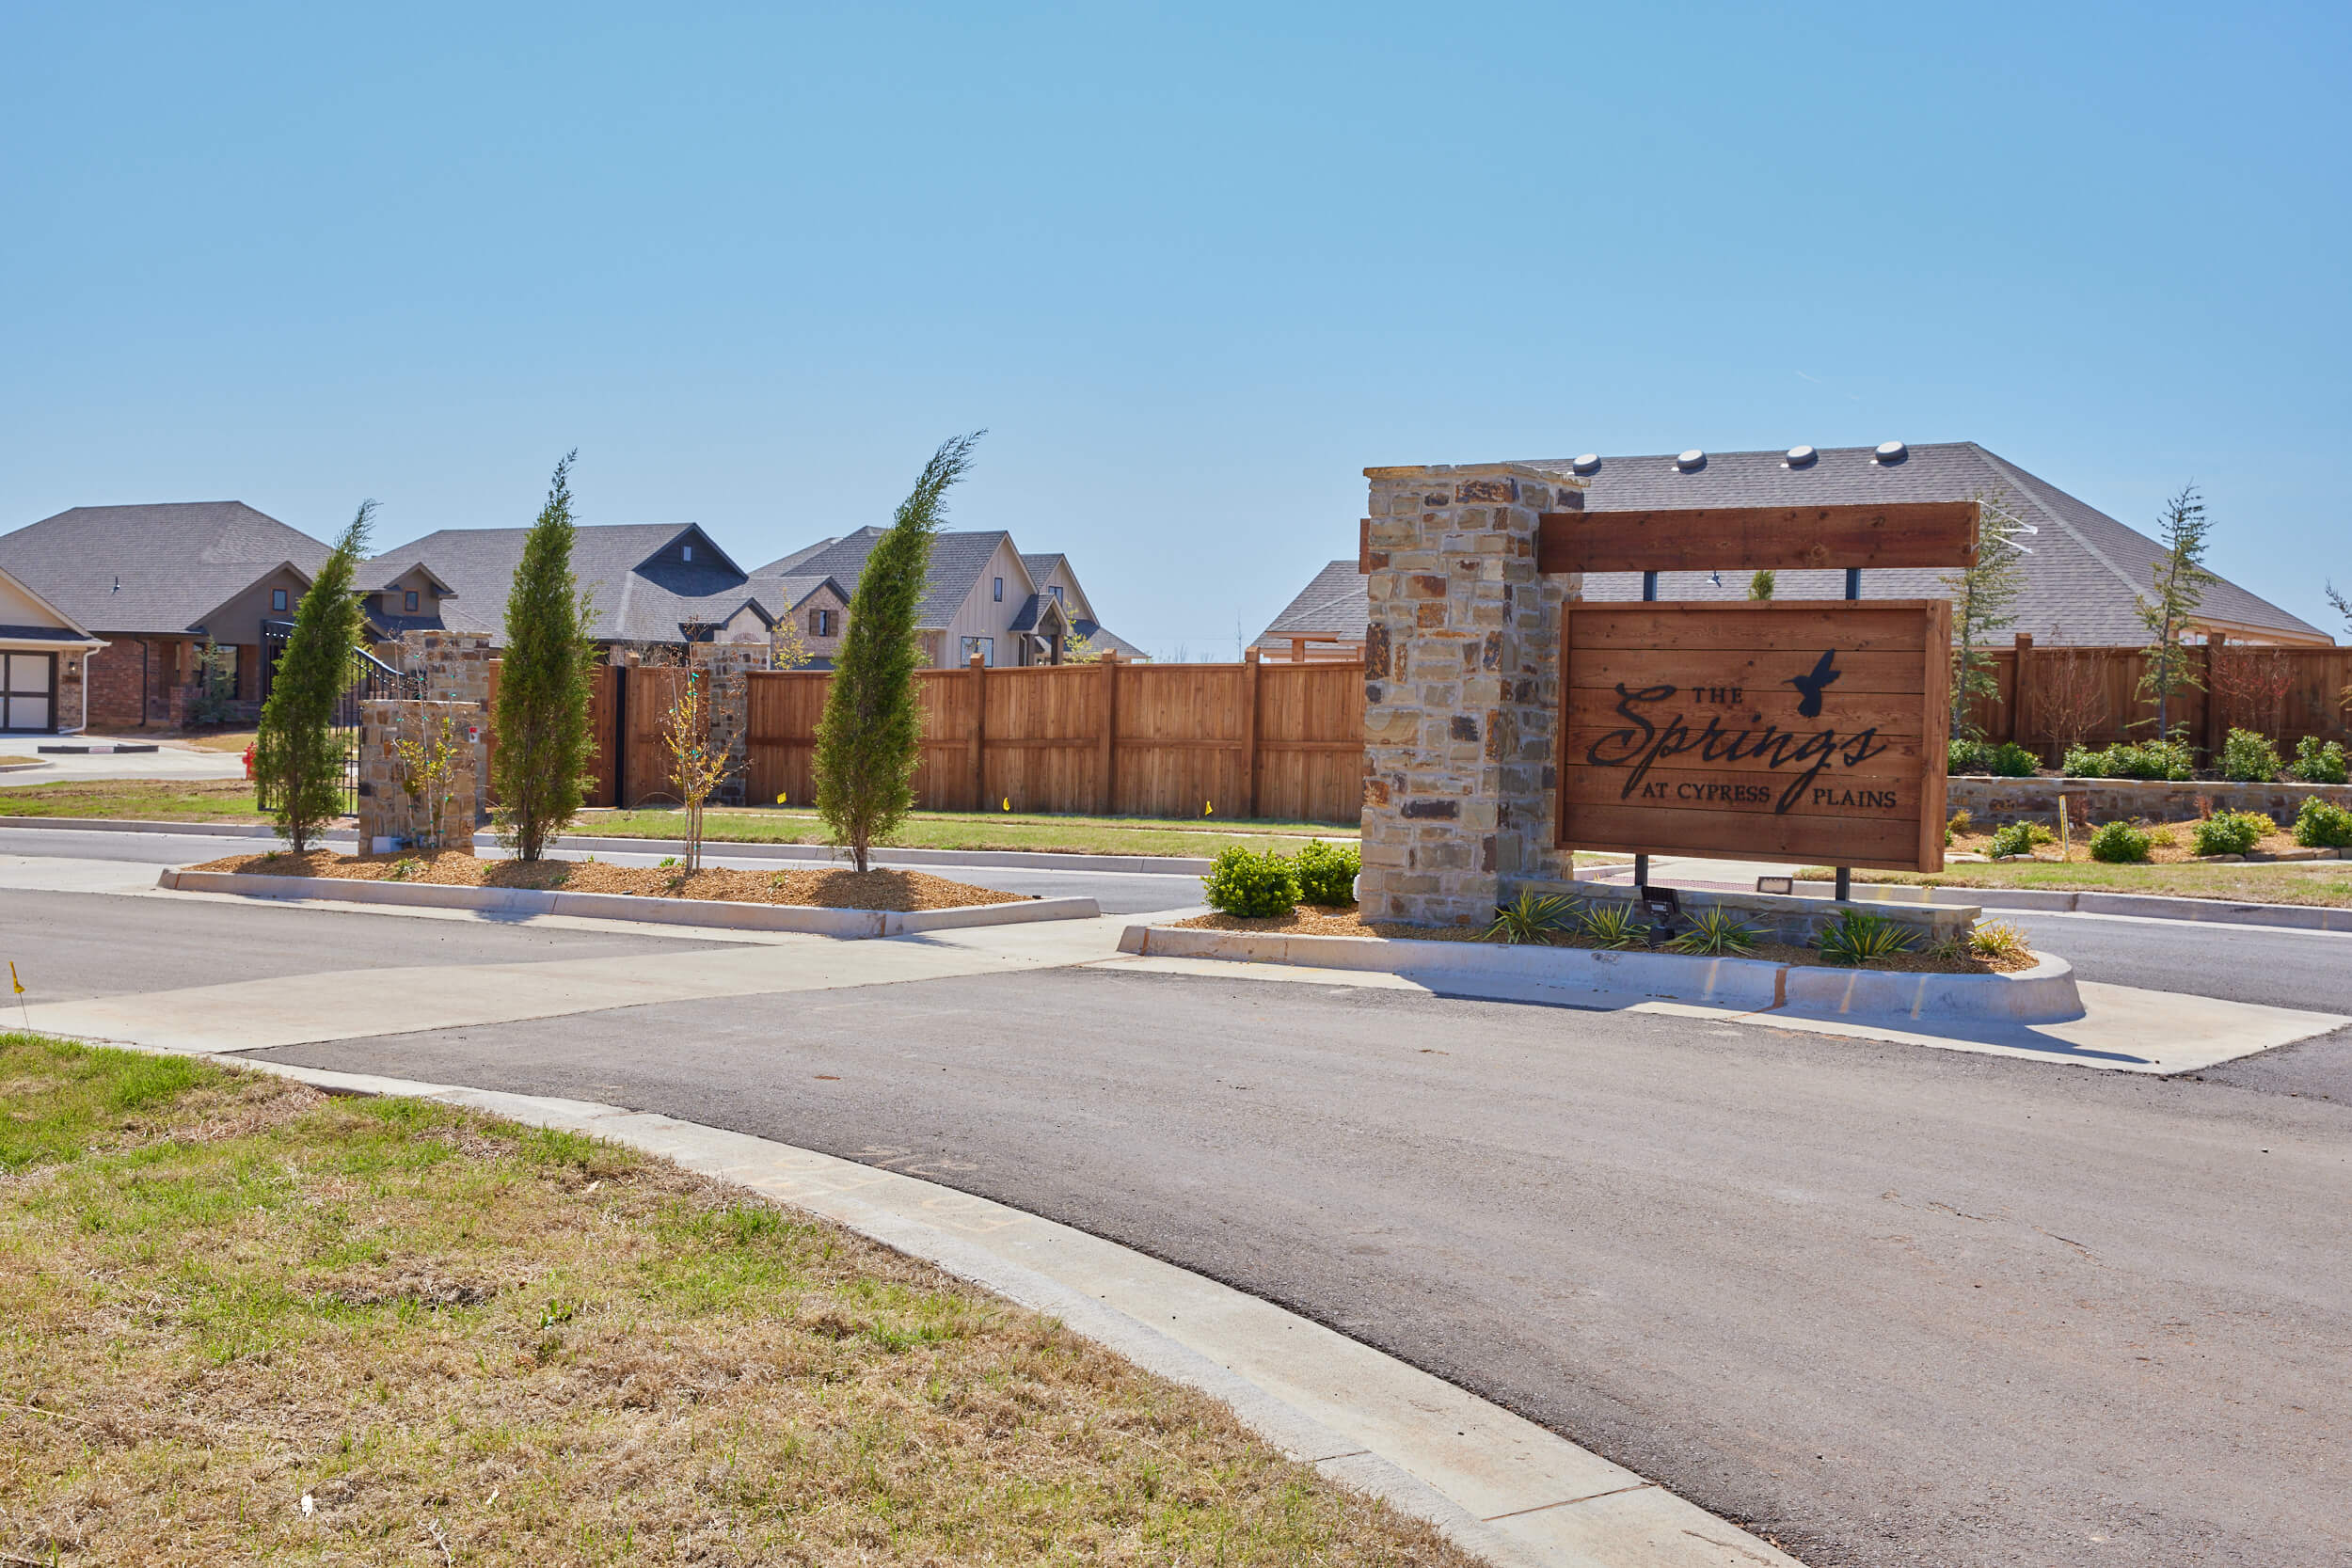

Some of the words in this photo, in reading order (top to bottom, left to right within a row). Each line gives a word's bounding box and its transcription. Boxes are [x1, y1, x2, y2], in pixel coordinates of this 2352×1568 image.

[1693, 687, 1743, 705] THE
[1586, 683, 1886, 815] Springs
[1641, 783, 1668, 799] AT
[1677, 783, 1771, 803] CYPRESS
[1813, 788, 1897, 809] PLAINS
